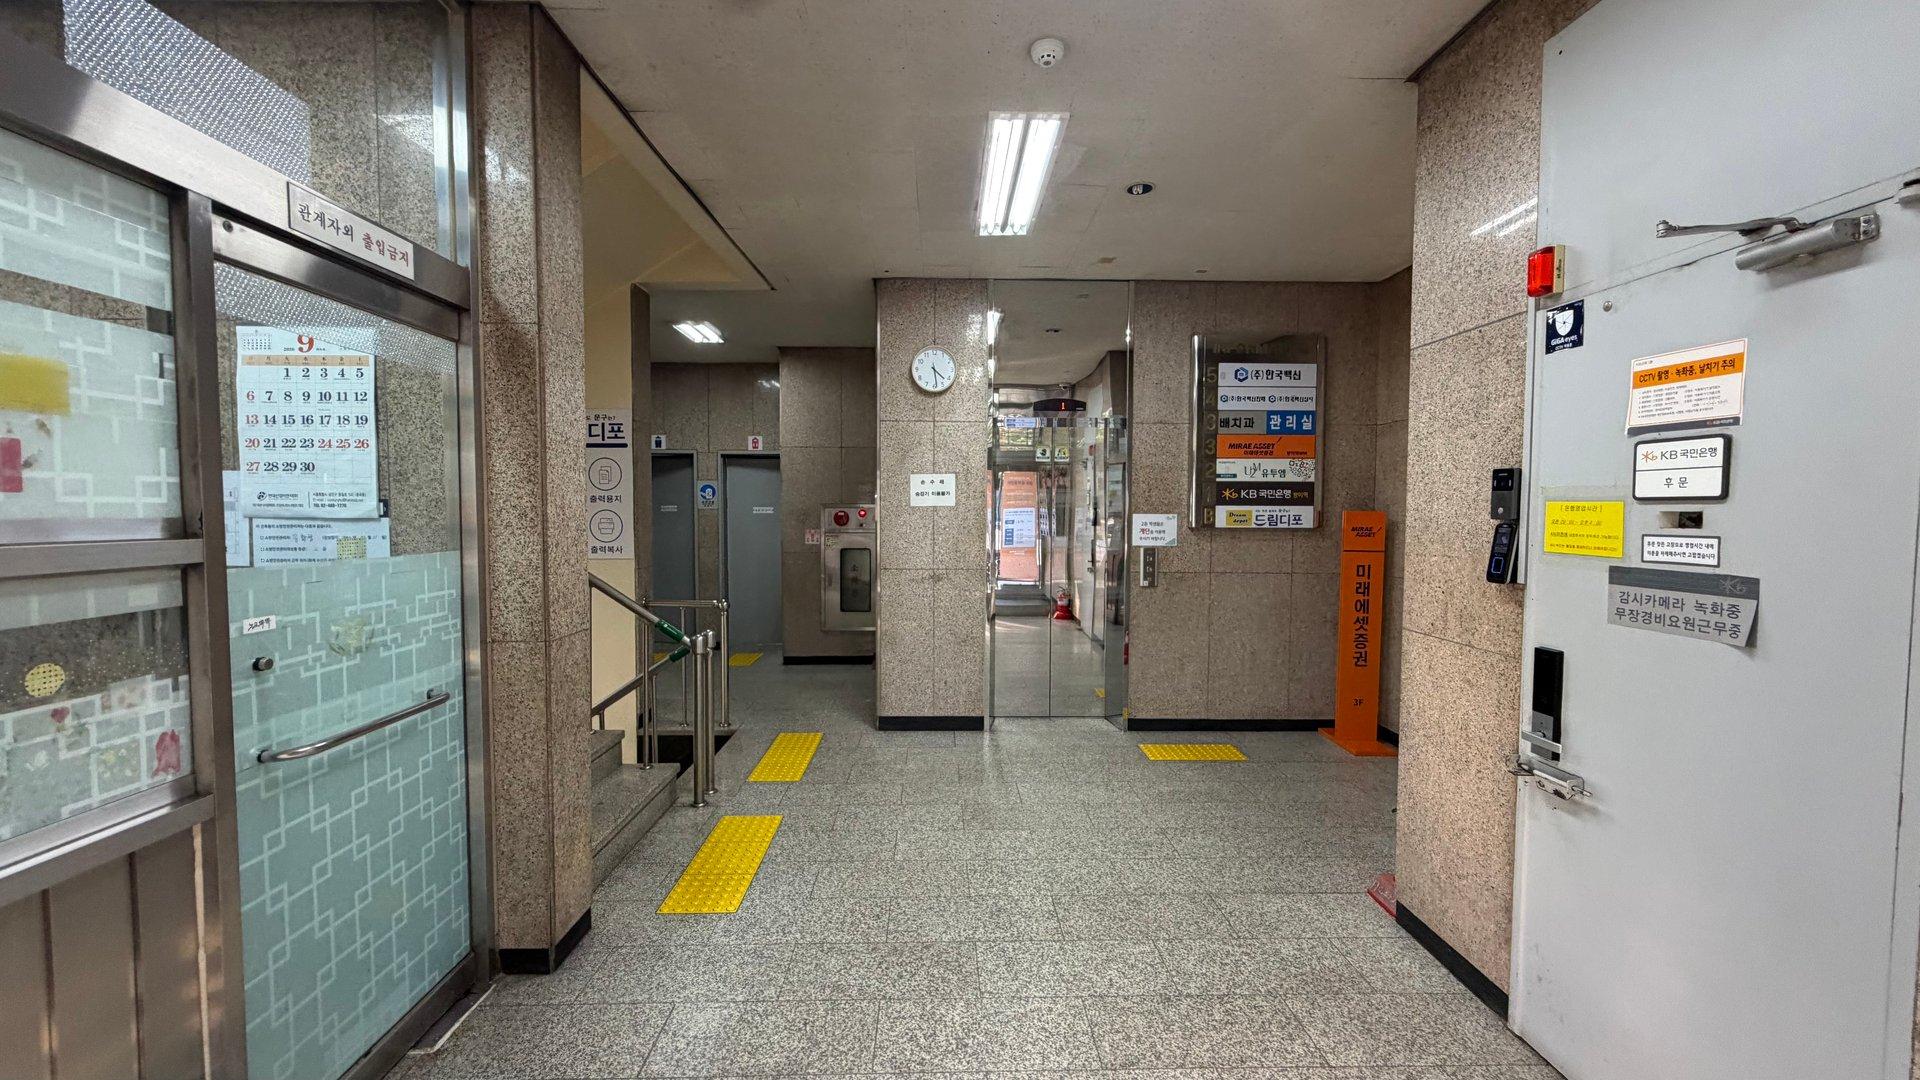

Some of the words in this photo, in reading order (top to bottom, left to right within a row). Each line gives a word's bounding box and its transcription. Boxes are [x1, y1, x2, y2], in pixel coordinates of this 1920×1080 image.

[298, 203, 354, 242] 관계자외
[362, 232, 409, 267] 출입금지
[297, 334, 315, 353] 9
[284, 368, 291, 378] 1
[302, 368, 310, 378] 2
[320, 368, 328, 378] 3
[337, 368, 346, 378] 4
[356, 368, 364, 378] 5
[1250, 369, 1301, 380] (주)한국백신
[1639, 372, 1655, 383] CCTV
[1657, 370, 1669, 381] 촬영
[1699, 361, 1719, 374] 날치기
[1721, 358, 1736, 370] 주의
[246, 390, 255, 401] 6
[265, 390, 274, 401] 7
[284, 390, 292, 401] 8
[302, 390, 311, 401] 9
[318, 390, 332, 401] 10
[336, 390, 348, 401] 11
[354, 390, 368, 401] 12
[244, 414, 259, 425] 13
[263, 414, 277, 425] 14
[281, 414, 296, 425] 15
[300, 414, 314, 425] 16
[318, 414, 332, 425] 17
[336, 414, 350, 425] 18
[354, 414, 368, 425] 19
[1220, 417, 1254, 428] 배치과
[244, 438, 260, 448] 20
[263, 438, 277, 448] 21
[281, 438, 296, 448] 22
[300, 438, 314, 448] 23
[318, 438, 333, 448] 24
[336, 438, 350, 448] 25
[354, 438, 369, 448] 26
[246, 462, 260, 472] 27
[264, 462, 279, 472] 28
[282, 462, 297, 472] 29
[300, 462, 315, 472] 30
[1254, 514, 1303, 526] 드림디포
[1618, 591, 1685, 612] 감시카메라
[1694, 600, 1740, 620] 녹화중
[1352, 564, 1371, 667] 미래에셋증권
[1615, 607, 1741, 639] 무장경비요원근무중
[1353, 698, 1364, 707] 3F
